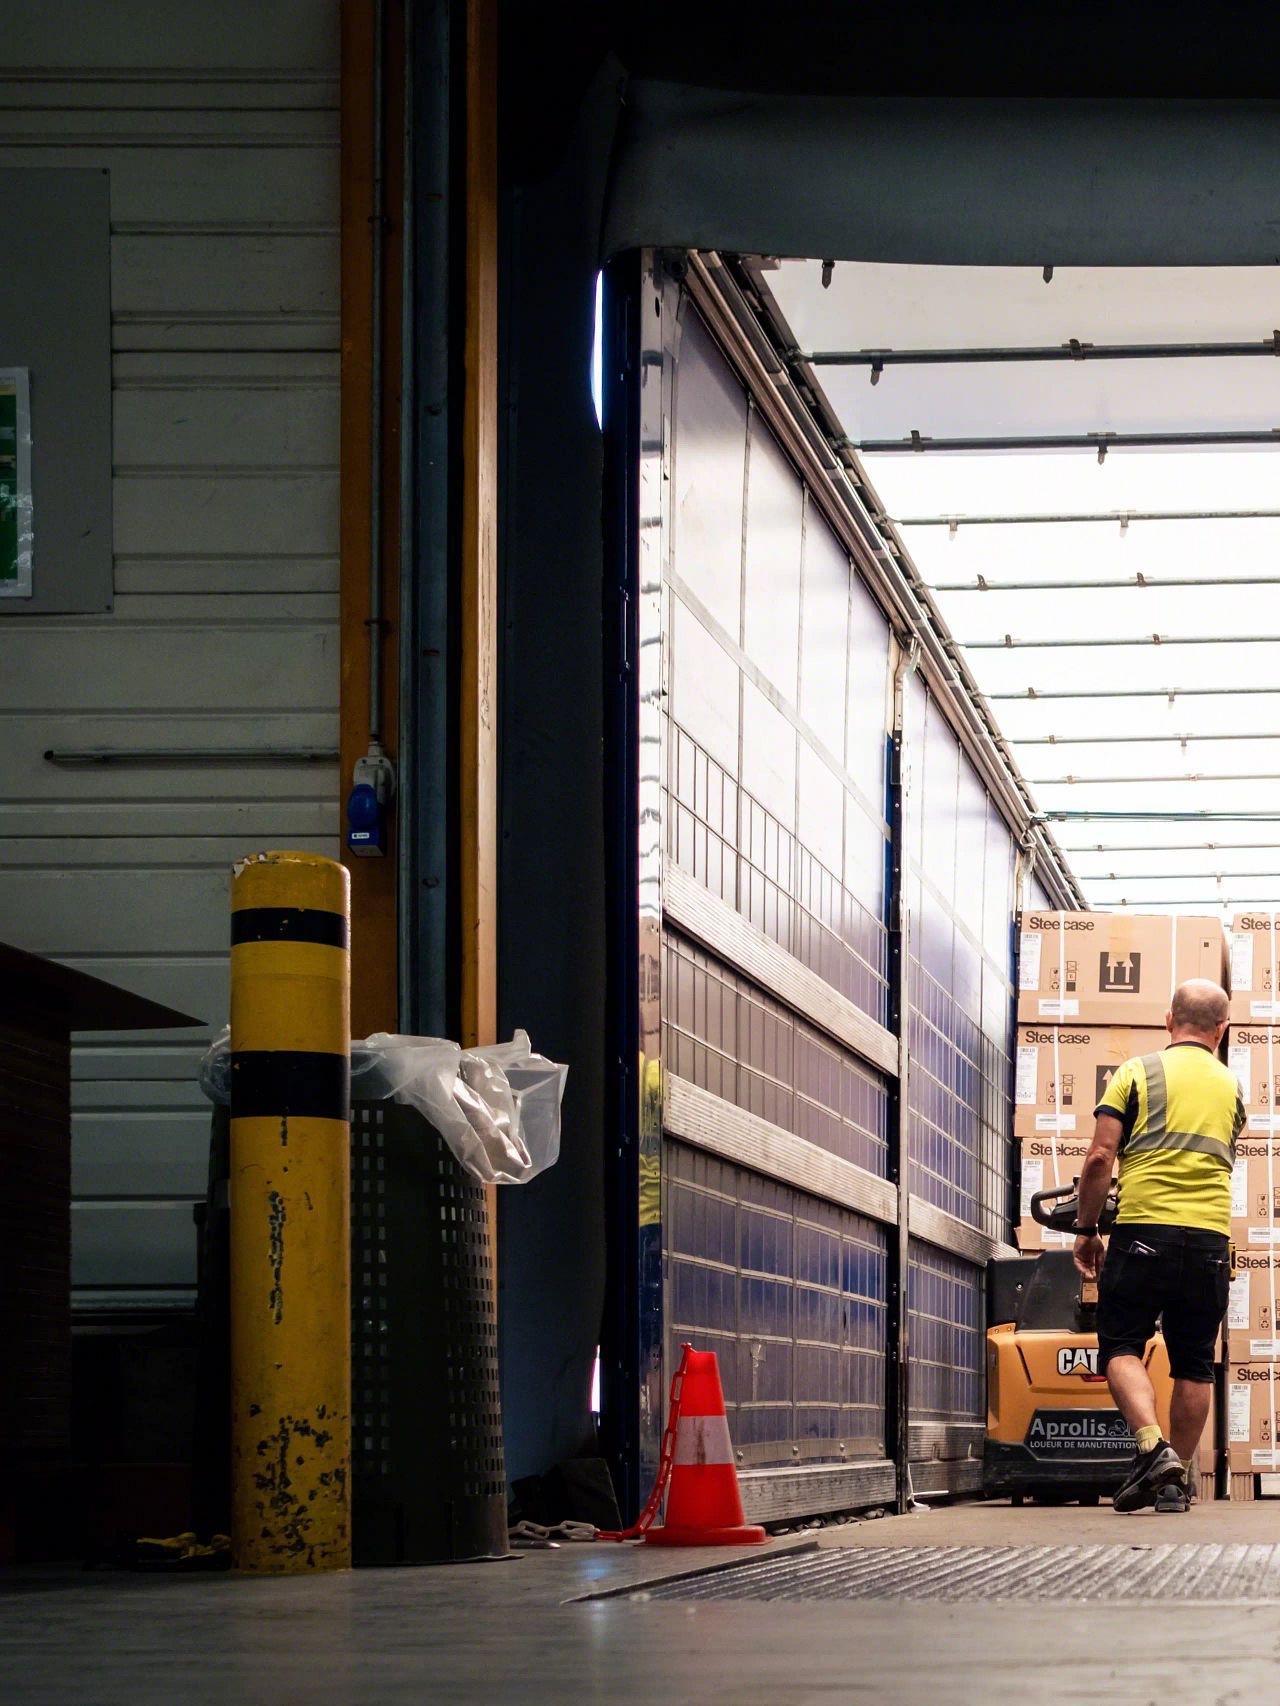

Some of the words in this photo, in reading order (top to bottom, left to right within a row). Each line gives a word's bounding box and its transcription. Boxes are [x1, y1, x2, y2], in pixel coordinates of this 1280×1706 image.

[1029, 916, 1095, 931] Steecase
[1030, 1143, 1087, 1157] Steelcas
[1058, 1348, 1099, 1375] CAT
[1031, 1418, 1107, 1440] Aprolis
[1030, 1440, 1062, 1449] LOUEUR
[1065, 1441, 1075, 1449] DE
